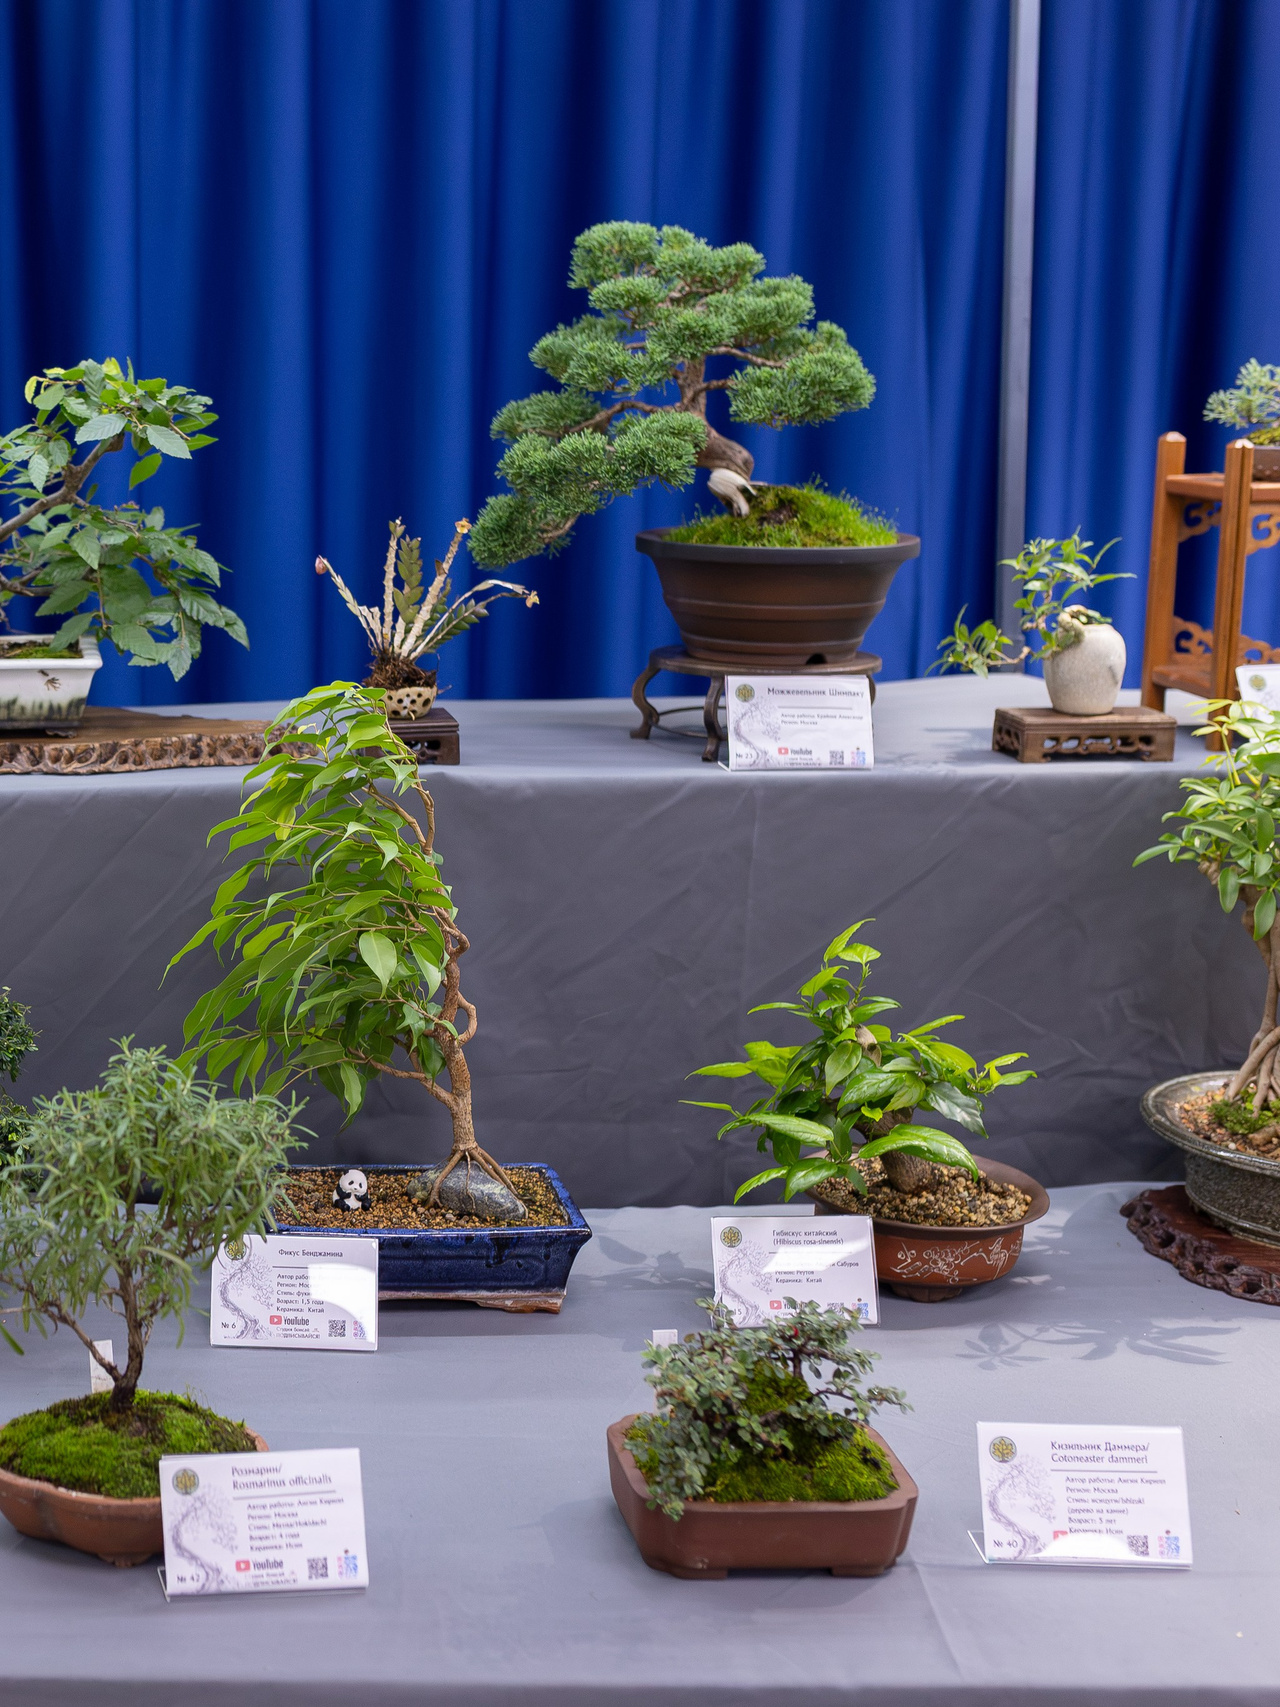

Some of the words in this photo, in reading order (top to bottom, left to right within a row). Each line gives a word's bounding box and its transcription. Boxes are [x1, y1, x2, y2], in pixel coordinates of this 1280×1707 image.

[767, 688, 826, 696] Можжевельник
[279, 1249, 300, 1257] Фикус
[302, 1249, 343, 1258] Бенджамина
[284, 1316, 309, 1325] YouTube
[1051, 1441, 1101, 1451] Кизильник
[1105, 1442, 1149, 1452] Даммера/
[1051, 1454, 1104, 1463] Cotoneaster
[1108, 1455, 1148, 1464] dammeri
[233, 1479, 286, 1491] Rosmarinus
[1007, 1540, 1018, 1548] 40
[253, 1559, 283, 1570] YouTube
